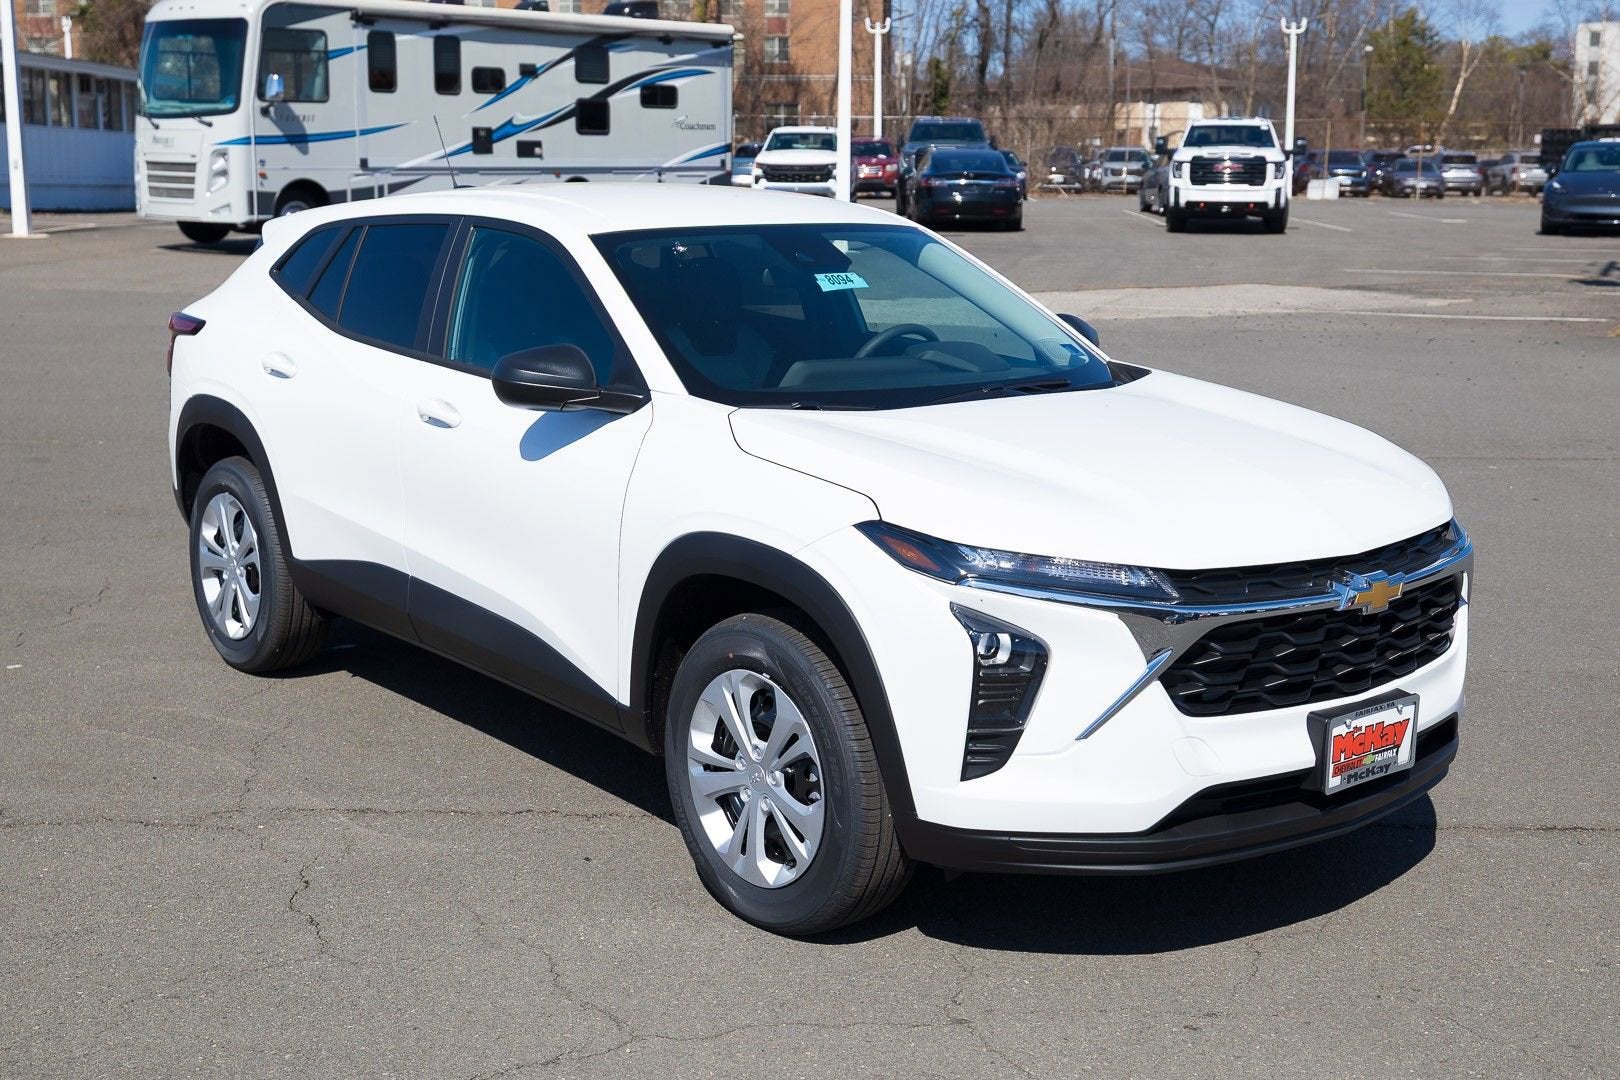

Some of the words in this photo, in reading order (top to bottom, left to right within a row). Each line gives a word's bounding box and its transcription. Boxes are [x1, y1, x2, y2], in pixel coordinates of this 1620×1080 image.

[824, 274, 854, 285] 8094
[1332, 718, 1411, 764] McKay
[1346, 762, 1392, 784] McKay
